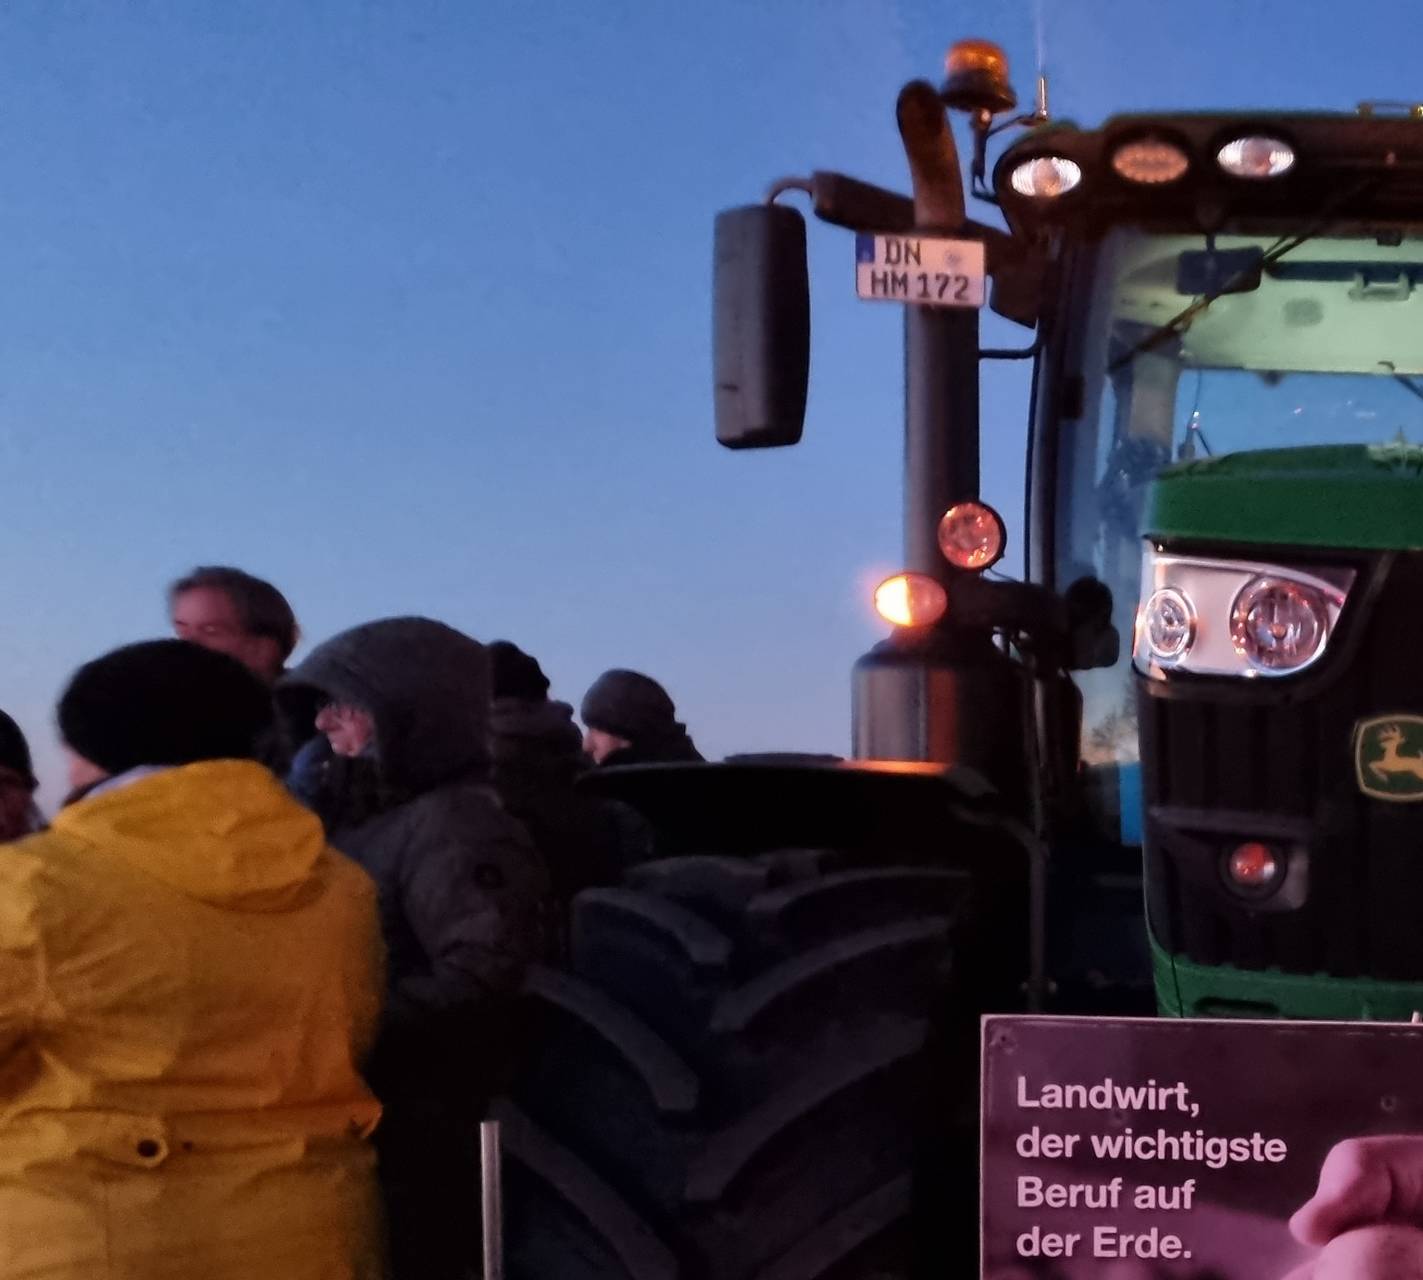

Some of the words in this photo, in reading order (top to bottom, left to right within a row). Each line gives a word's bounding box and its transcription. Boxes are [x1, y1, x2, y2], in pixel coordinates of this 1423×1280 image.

[885, 239, 921, 266] DN
[871, 269, 908, 296] HM
[917, 272, 969, 300] 172
[1016, 1075, 1200, 1118] Landwirt,
[1015, 1126, 1080, 1158] der
[1090, 1128, 1288, 1169] wichtigste
[1017, 1175, 1123, 1208] Beruf
[1133, 1178, 1196, 1210] auf
[1015, 1226, 1081, 1258] der
[1093, 1226, 1192, 1259] Erde.
